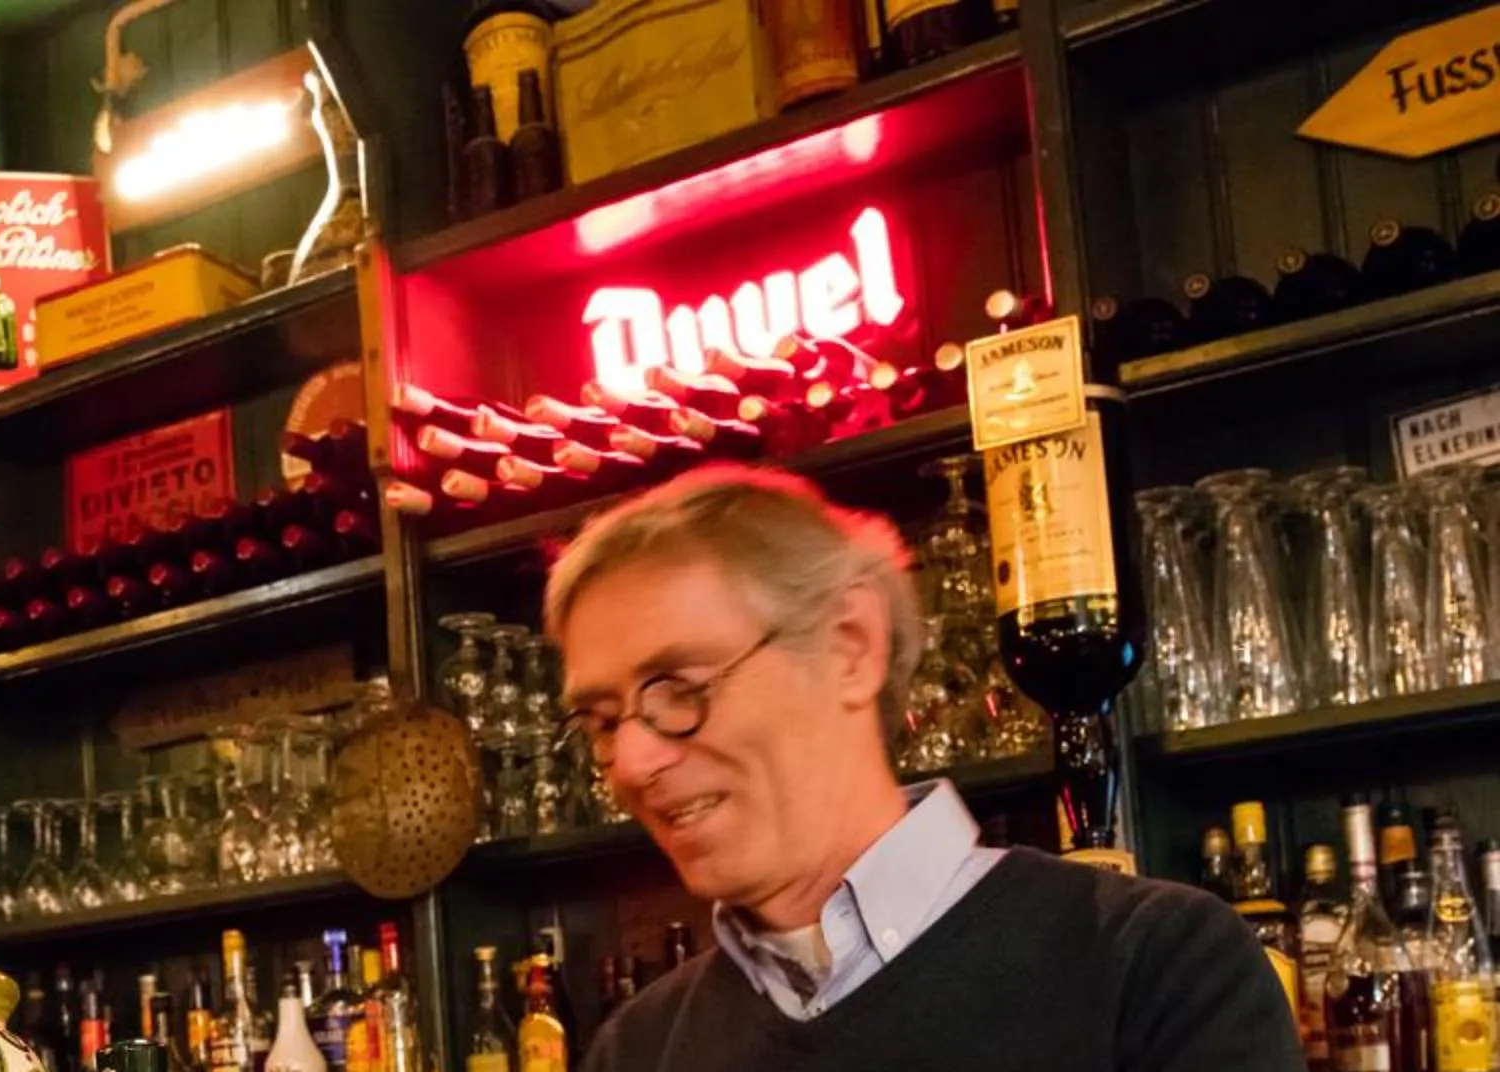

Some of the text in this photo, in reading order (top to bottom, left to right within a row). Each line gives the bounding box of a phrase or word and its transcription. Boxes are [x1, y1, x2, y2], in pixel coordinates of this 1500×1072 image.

[1385, 42, 1500, 115] Fuss
[581, 205, 905, 394] Duvel
[980, 334, 1067, 368] JAMESON
[1412, 423, 1500, 466] ELKERIN
[80, 457, 216, 522] DIVIETO
